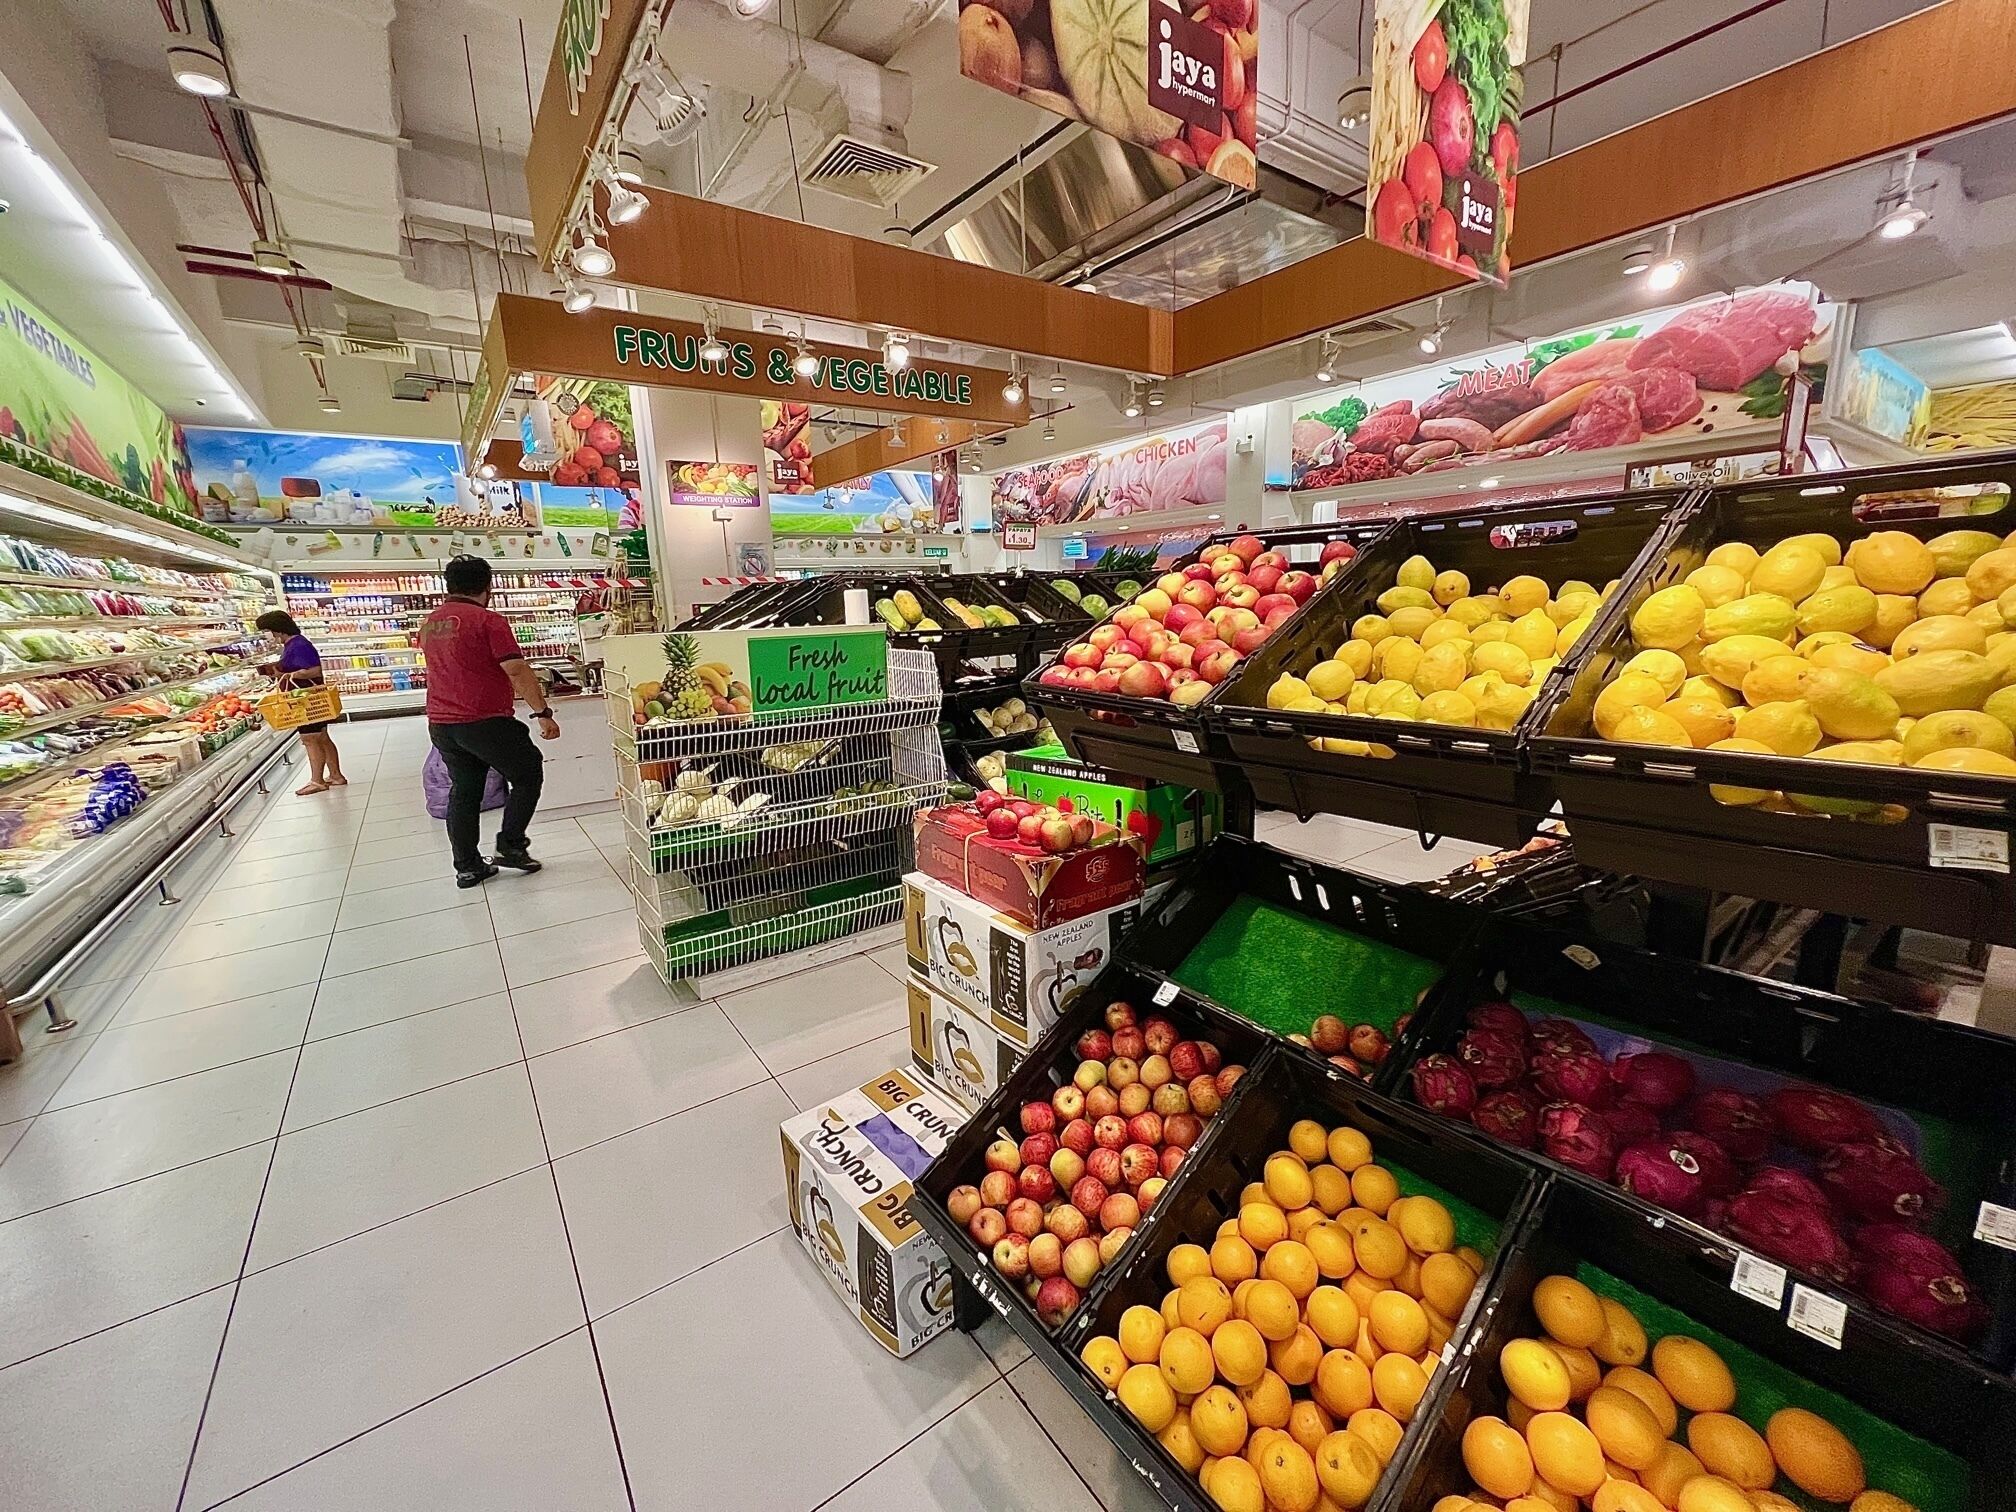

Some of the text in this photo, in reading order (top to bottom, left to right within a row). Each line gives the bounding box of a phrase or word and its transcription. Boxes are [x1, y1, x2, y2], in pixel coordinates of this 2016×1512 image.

[1158, 18, 1216, 89] jaya
[1172, 76, 1216, 107] hypermart
[1461, 180, 1493, 228] jaya
[6, 299, 96, 391] VEGETABLES
[767, 348, 797, 385] &
[1456, 358, 1536, 398] MEAT
[618, 453, 639, 472] jay
[1135, 437, 1197, 464] CHICKEN
[777, 463, 798, 480] jaya
[1017, 466, 1064, 488] SEAFOOD
[1674, 467, 1731, 482] Olive Oil
[683, 495, 753, 504] WEIGHTING STATION
[789, 639, 849, 672] Fresh
[756, 667, 884, 704] local fruit
[1033, 764, 1106, 782] NEW ZEALAND APPLES
[1043, 920, 1094, 944] NEW ZEALAND
[1057, 933, 1083, 948] APPLES
[930, 958, 945, 978] BIG
[949, 971, 990, 1008] CRUNCH
[935, 1059, 952, 1080] BIG
[877, 1079, 954, 1139] BIG CRUN
[816, 1136, 917, 1230] BIG CRUNCH
[802, 1223, 859, 1304] BIG CRUNCH
[911, 1324, 934, 1349] BIG
